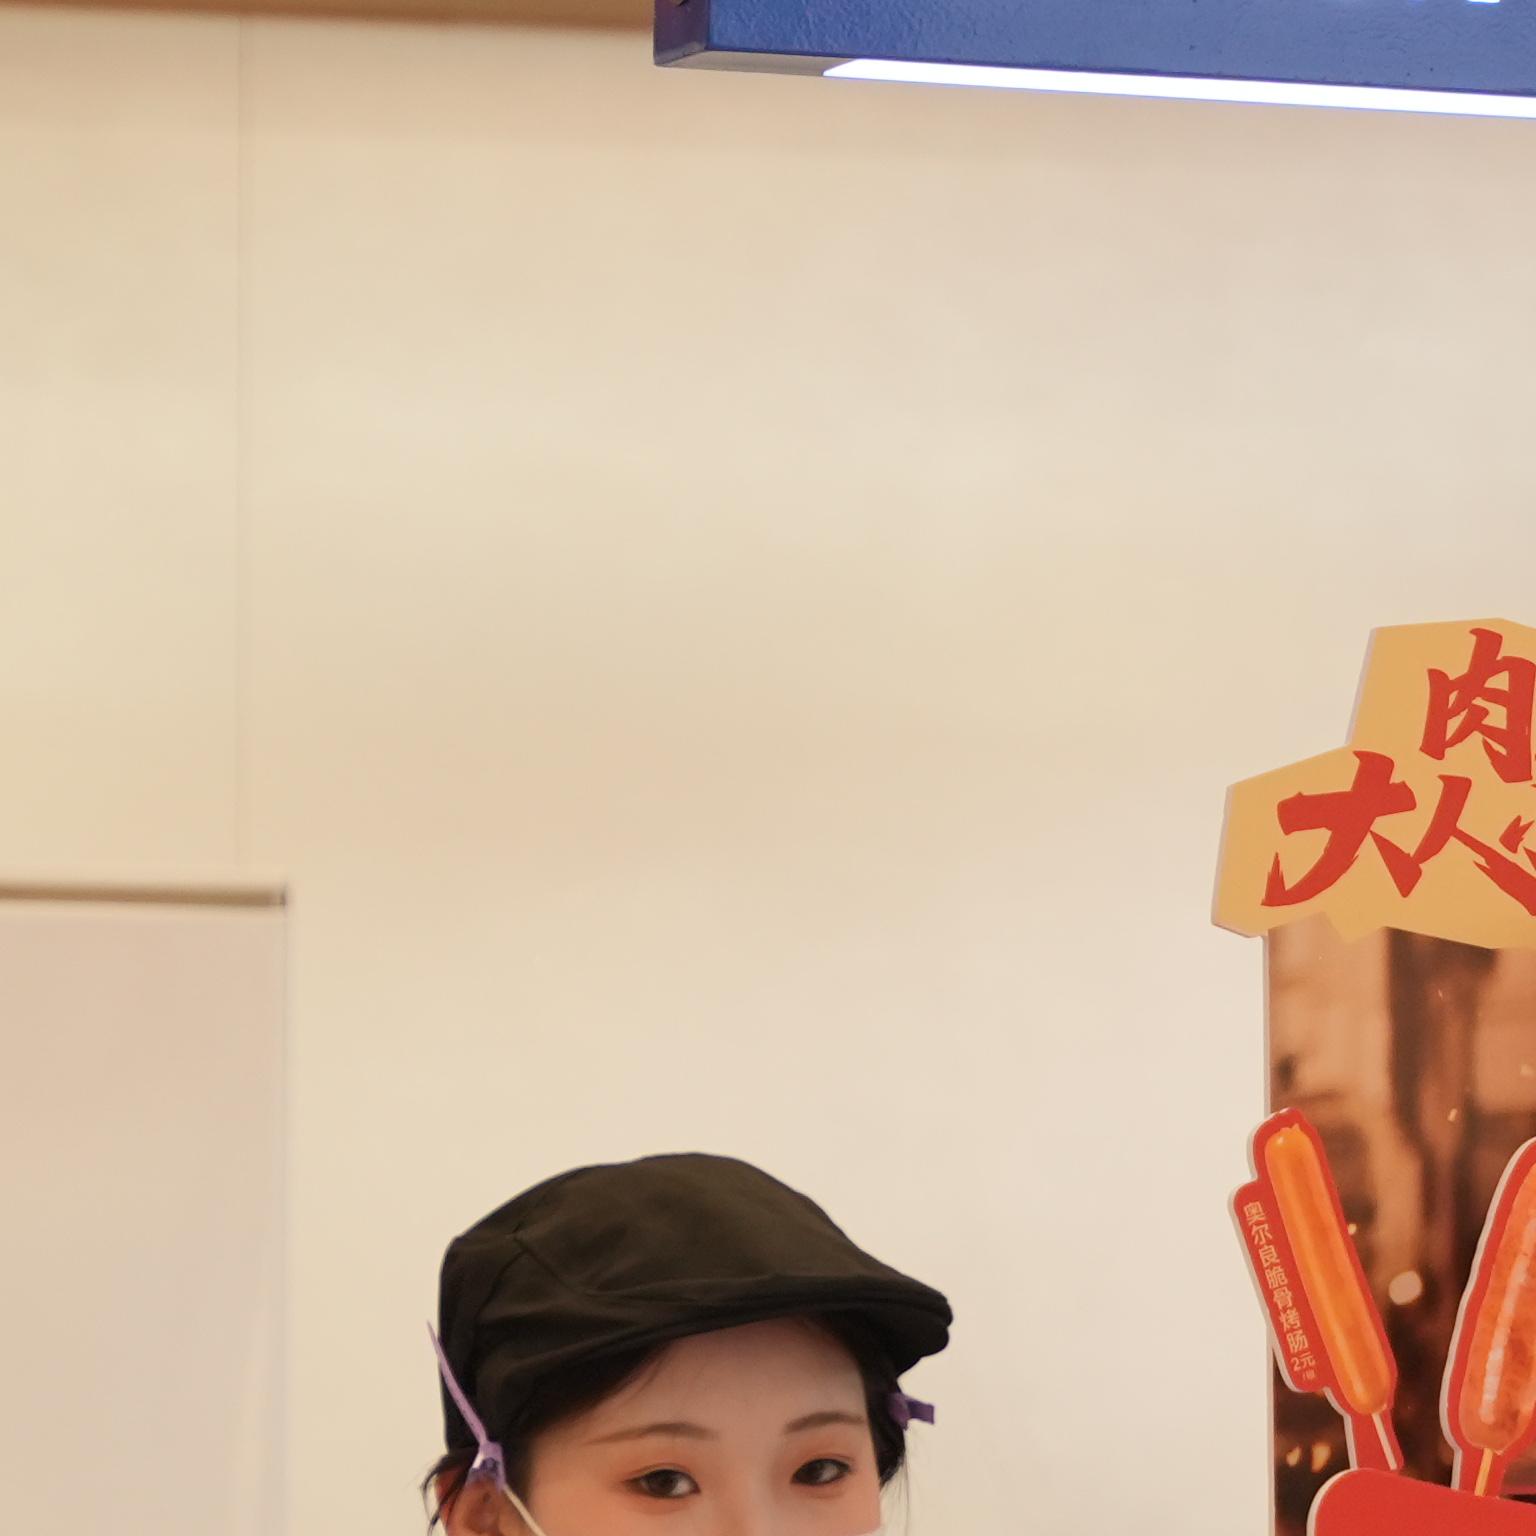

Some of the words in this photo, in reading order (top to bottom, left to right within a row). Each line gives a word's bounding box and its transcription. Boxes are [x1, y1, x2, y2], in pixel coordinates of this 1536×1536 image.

[1243, 1201, 1309, 1354] 奥尔良脆骨烤肠
